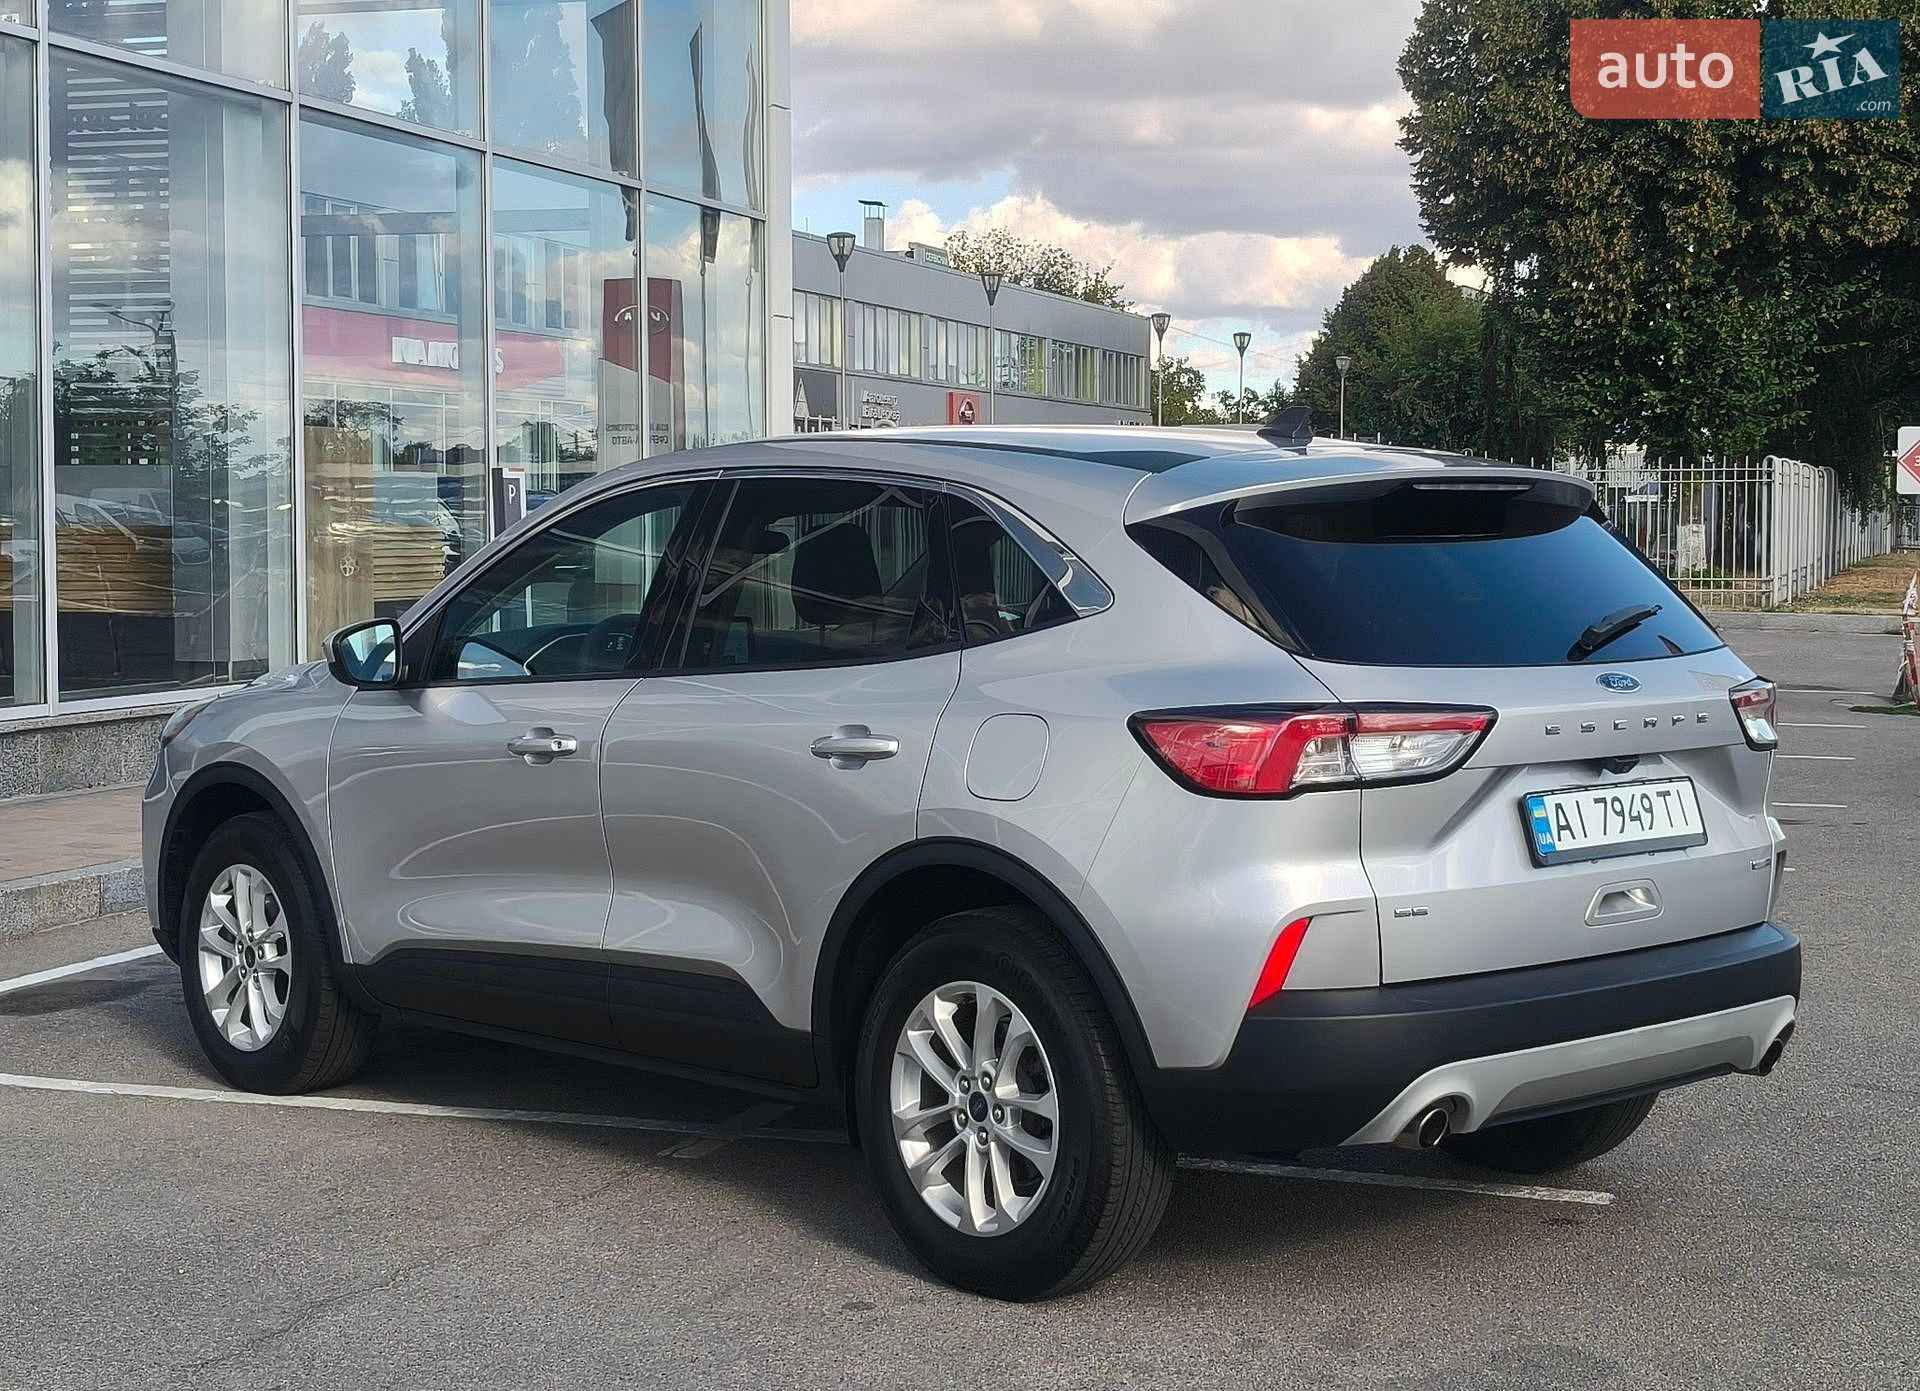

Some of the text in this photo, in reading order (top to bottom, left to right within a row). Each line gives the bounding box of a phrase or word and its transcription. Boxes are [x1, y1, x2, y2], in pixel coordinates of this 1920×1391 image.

[508, 484, 516, 505] P
[1601, 674, 1636, 689] Ford
[1544, 711, 1710, 736] ESCAPE
[1553, 789, 1690, 843] AI 7949 TI
[1538, 831, 1554, 845] UA
[1393, 906, 1429, 918] SE
